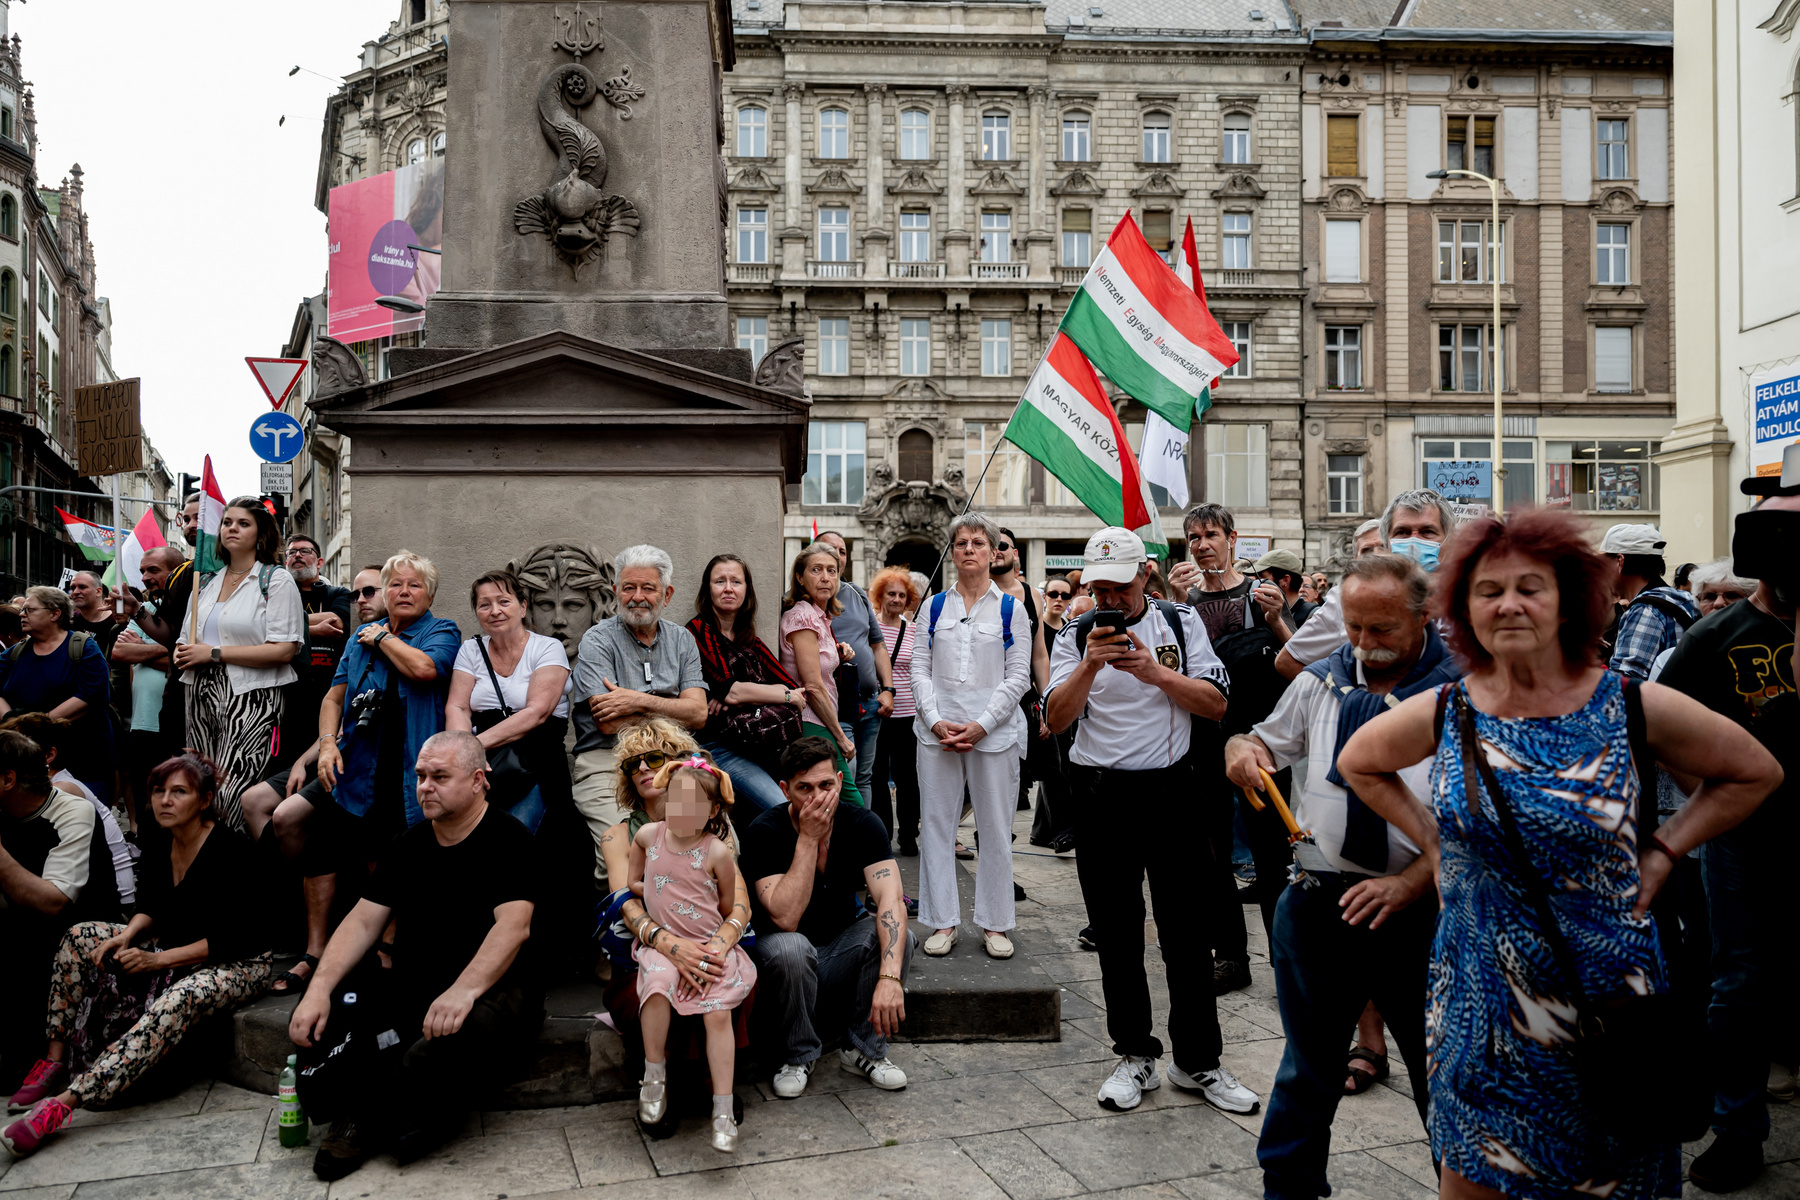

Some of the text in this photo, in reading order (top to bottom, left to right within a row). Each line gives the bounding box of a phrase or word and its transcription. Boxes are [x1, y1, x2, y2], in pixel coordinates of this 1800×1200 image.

[384, 245, 399, 257] Irány
[1095, 266, 1210, 381] Nemzeti Egység Magyarországért
[1043, 384, 1091, 435] MAGYAR
[1757, 399, 1798, 421] ATYÁM
[1095, 540, 1119, 548] BUDAPEST
[1046, 557, 1085, 567] GYÓGYSZER
